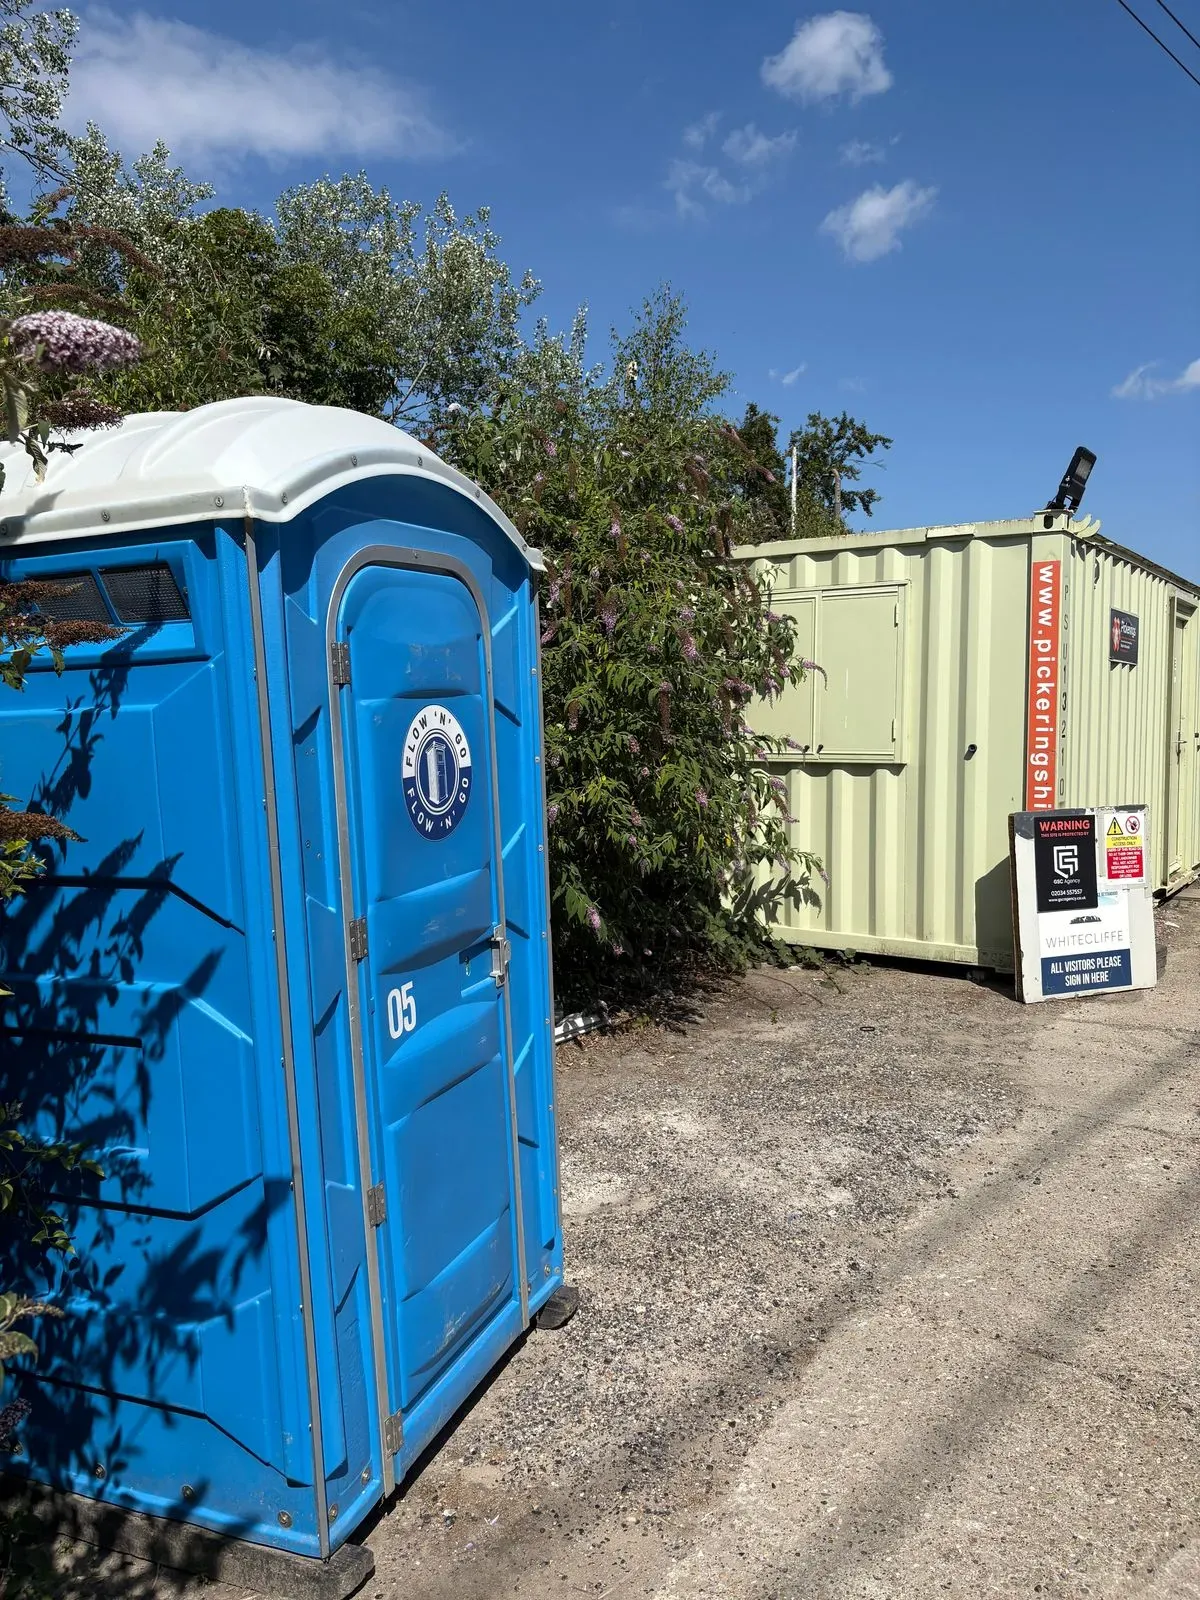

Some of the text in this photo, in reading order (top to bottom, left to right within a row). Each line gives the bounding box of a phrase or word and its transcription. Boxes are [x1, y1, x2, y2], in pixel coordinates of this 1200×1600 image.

[405, 714, 428, 767] FLOW
[455, 733, 467, 758] GO
[407, 787, 434, 832] FLOW
[459, 777, 469, 803] GO
[1039, 820, 1091, 832] WARNING
[1046, 930, 1124, 948] WHITECLIFFE
[1050, 956, 1122, 974] ALL VISITORS PLEASE
[1065, 970, 1109, 986] SIGN IN HERE
[388, 981, 416, 1039] 05
